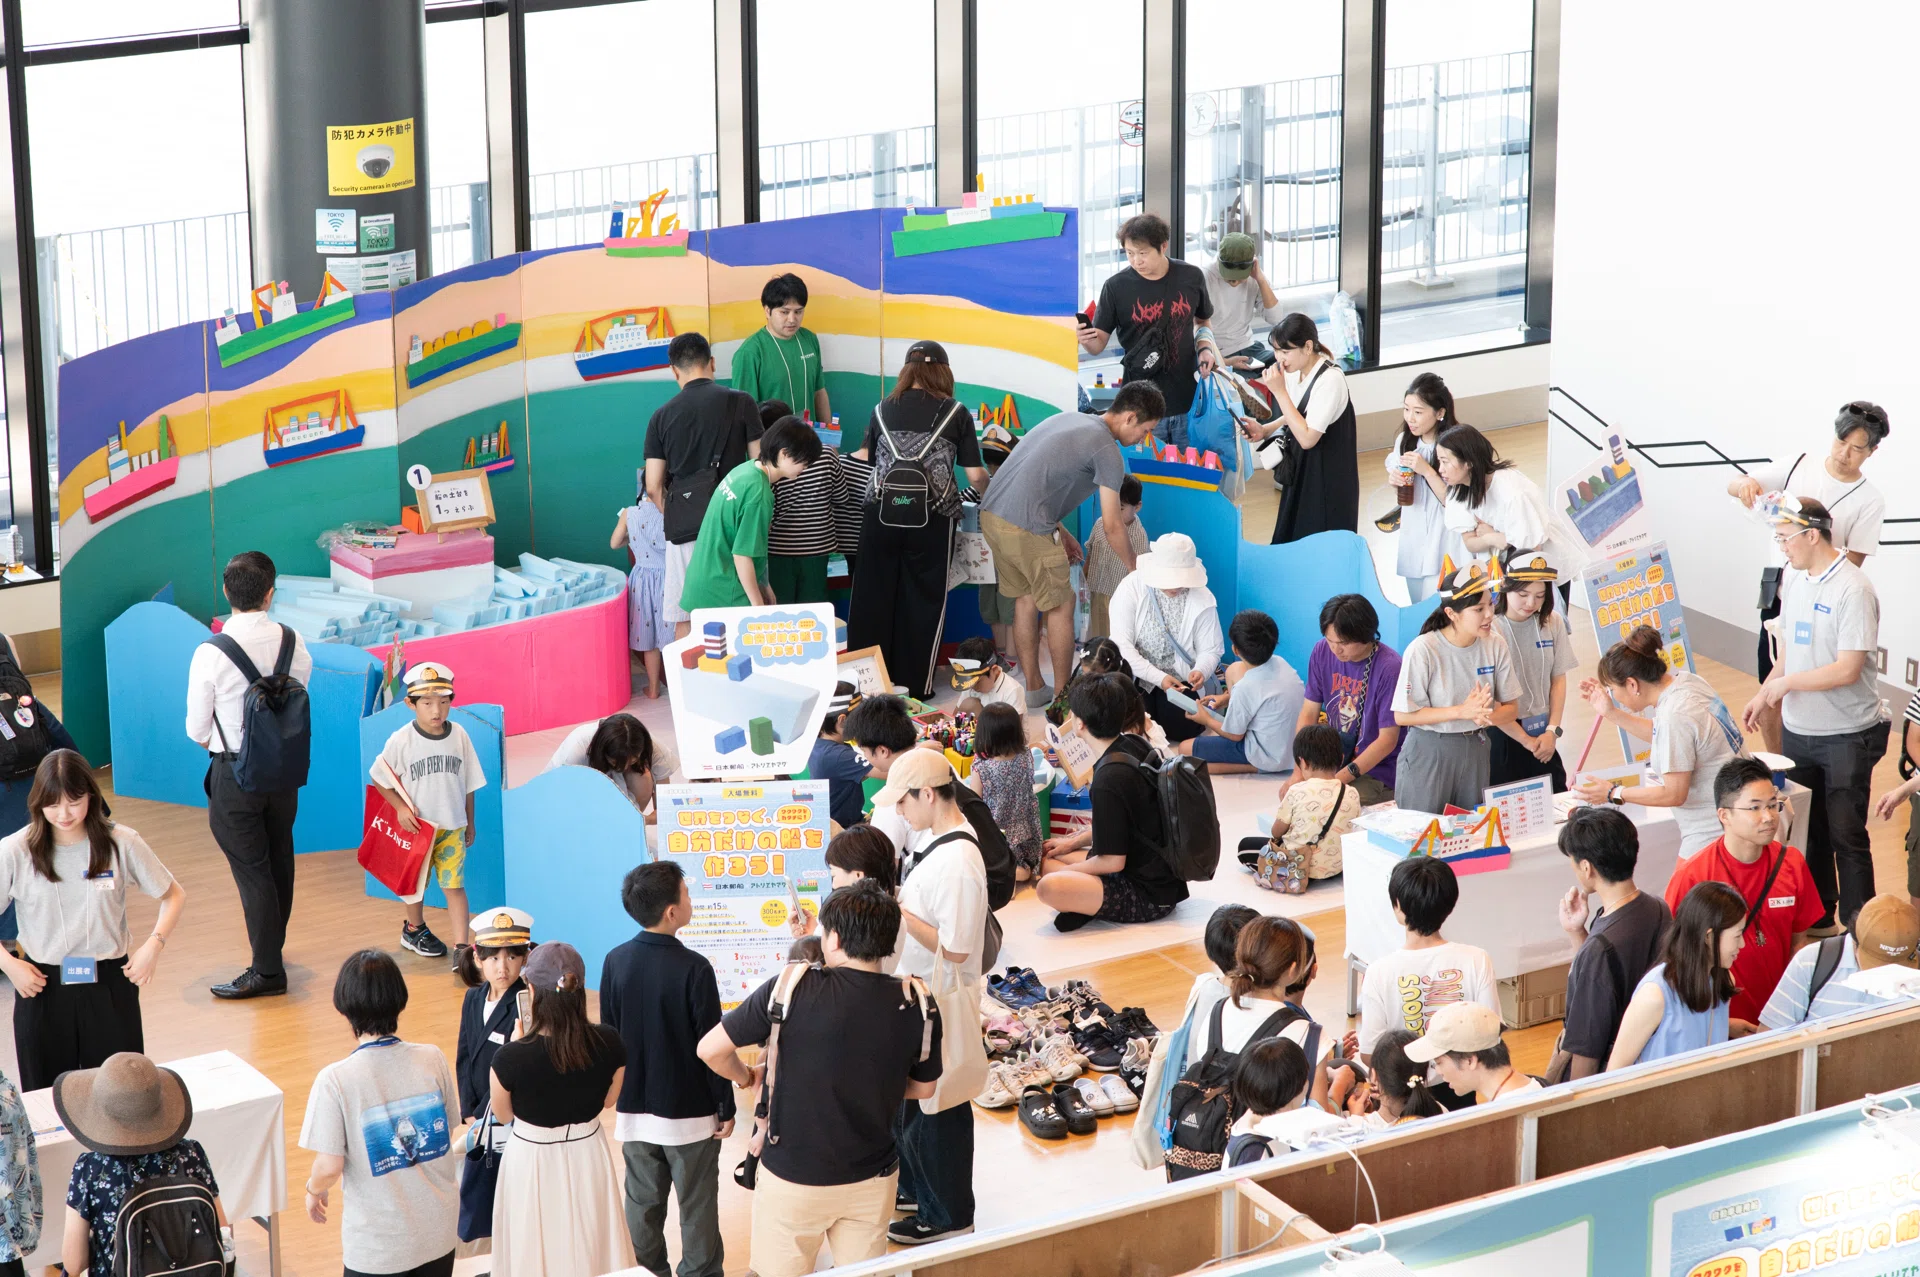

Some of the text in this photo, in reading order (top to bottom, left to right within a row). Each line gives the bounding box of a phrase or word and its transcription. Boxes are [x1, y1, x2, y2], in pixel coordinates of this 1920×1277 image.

[331, 122, 412, 141] 防犯カメラ作動中
[391, 178, 413, 188] operation
[367, 237, 389, 245] TOKYO
[413, 468, 423, 485] 1
[1597, 583, 1675, 628] 自分だけの船を
[742, 631, 823, 646] 自分だけの船を
[1049, 728, 1059, 744] 4
[410, 758, 426, 781] ENJOY
[427, 755, 444, 774] EVERY
[727, 789, 758, 797] 入場無料
[677, 808, 772, 827] 世界をつなぐ、
[385, 826, 412, 851] LINE
[668, 828, 824, 852] 自分だけの船を
[704, 854, 785, 878] 作ろう！
[1879, 943, 1896, 952] NEW
[734, 952, 739, 961] 3
[67, 967, 91, 975] 出展者
[1181, 1120, 1199, 1129] GREGORY
